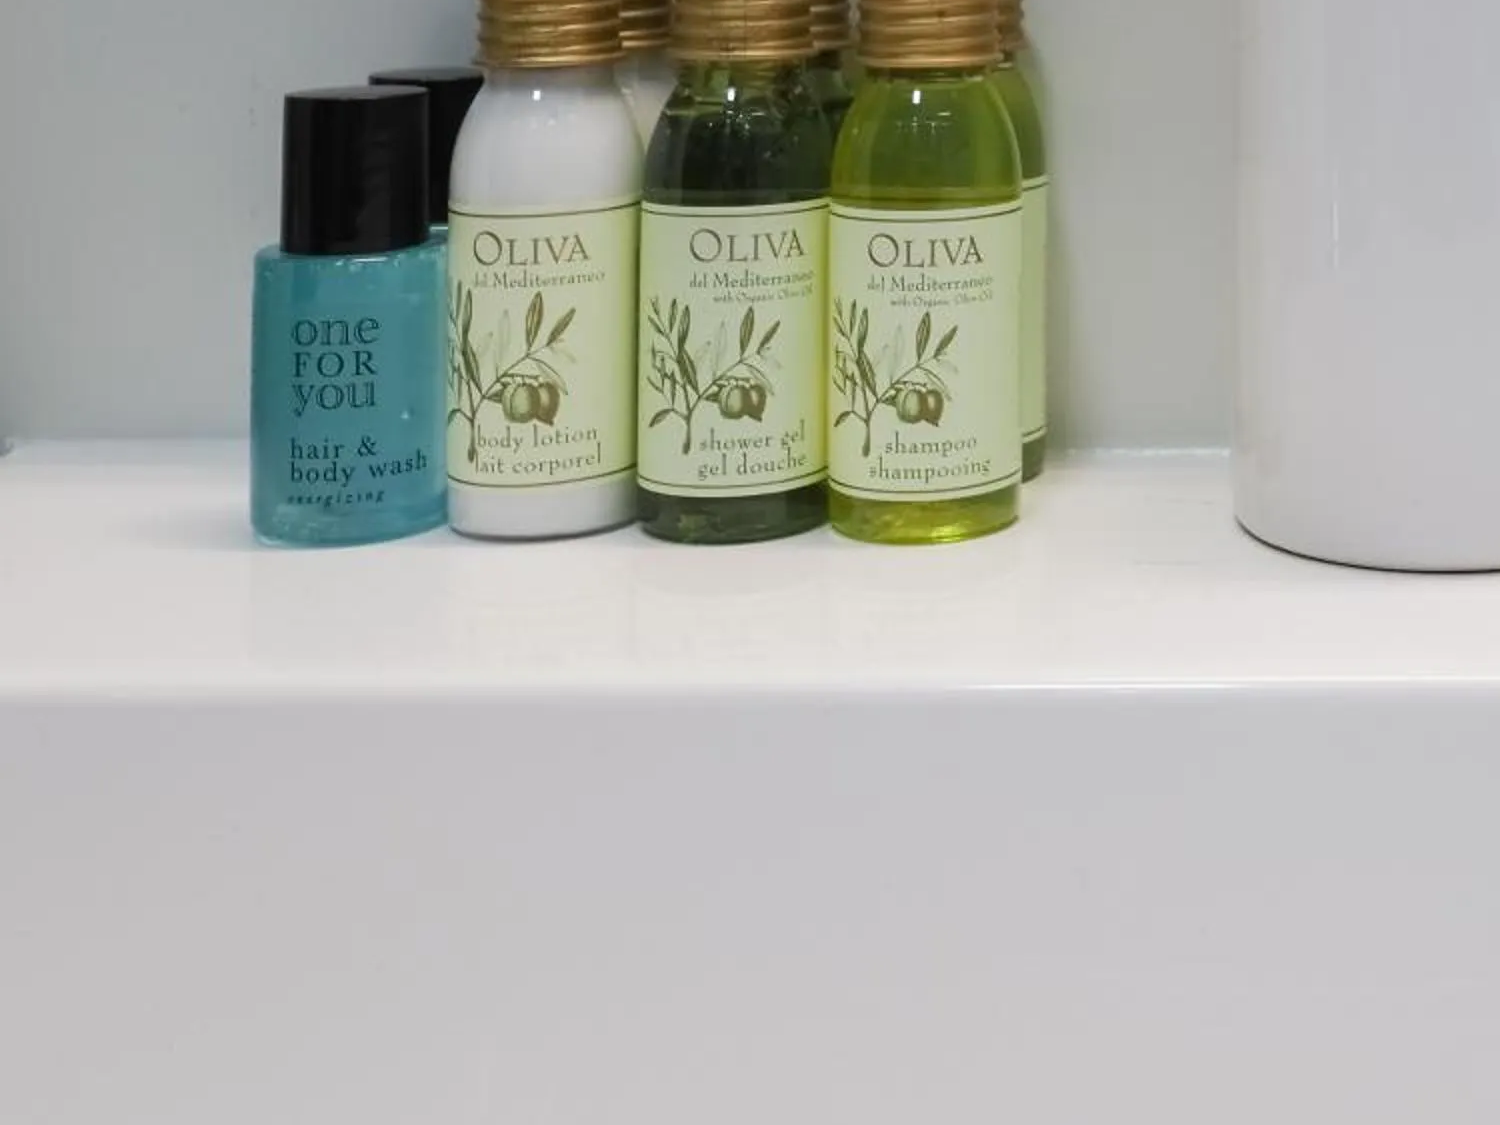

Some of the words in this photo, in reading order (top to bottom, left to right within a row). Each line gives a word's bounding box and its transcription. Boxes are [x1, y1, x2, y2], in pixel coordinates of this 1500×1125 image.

[472, 230, 591, 266] OLIVA
[689, 228, 806, 263] OLIVA
[867, 232, 984, 268] OLIVA
[290, 316, 382, 347] one
[293, 350, 378, 378] FOR
[291, 381, 377, 417] you
[289, 436, 345, 460] hair
[357, 435, 377, 458] &
[476, 424, 524, 453] body
[532, 425, 598, 448] lotion
[699, 428, 773, 452] shower
[780, 419, 806, 448] gel
[885, 431, 978, 458] shampoo
[289, 460, 356, 488] body
[368, 448, 428, 479] wash
[518, 441, 602, 477] corporel
[697, 452, 728, 481] gel
[736, 447, 807, 475] douche
[869, 457, 993, 483] shampooing
